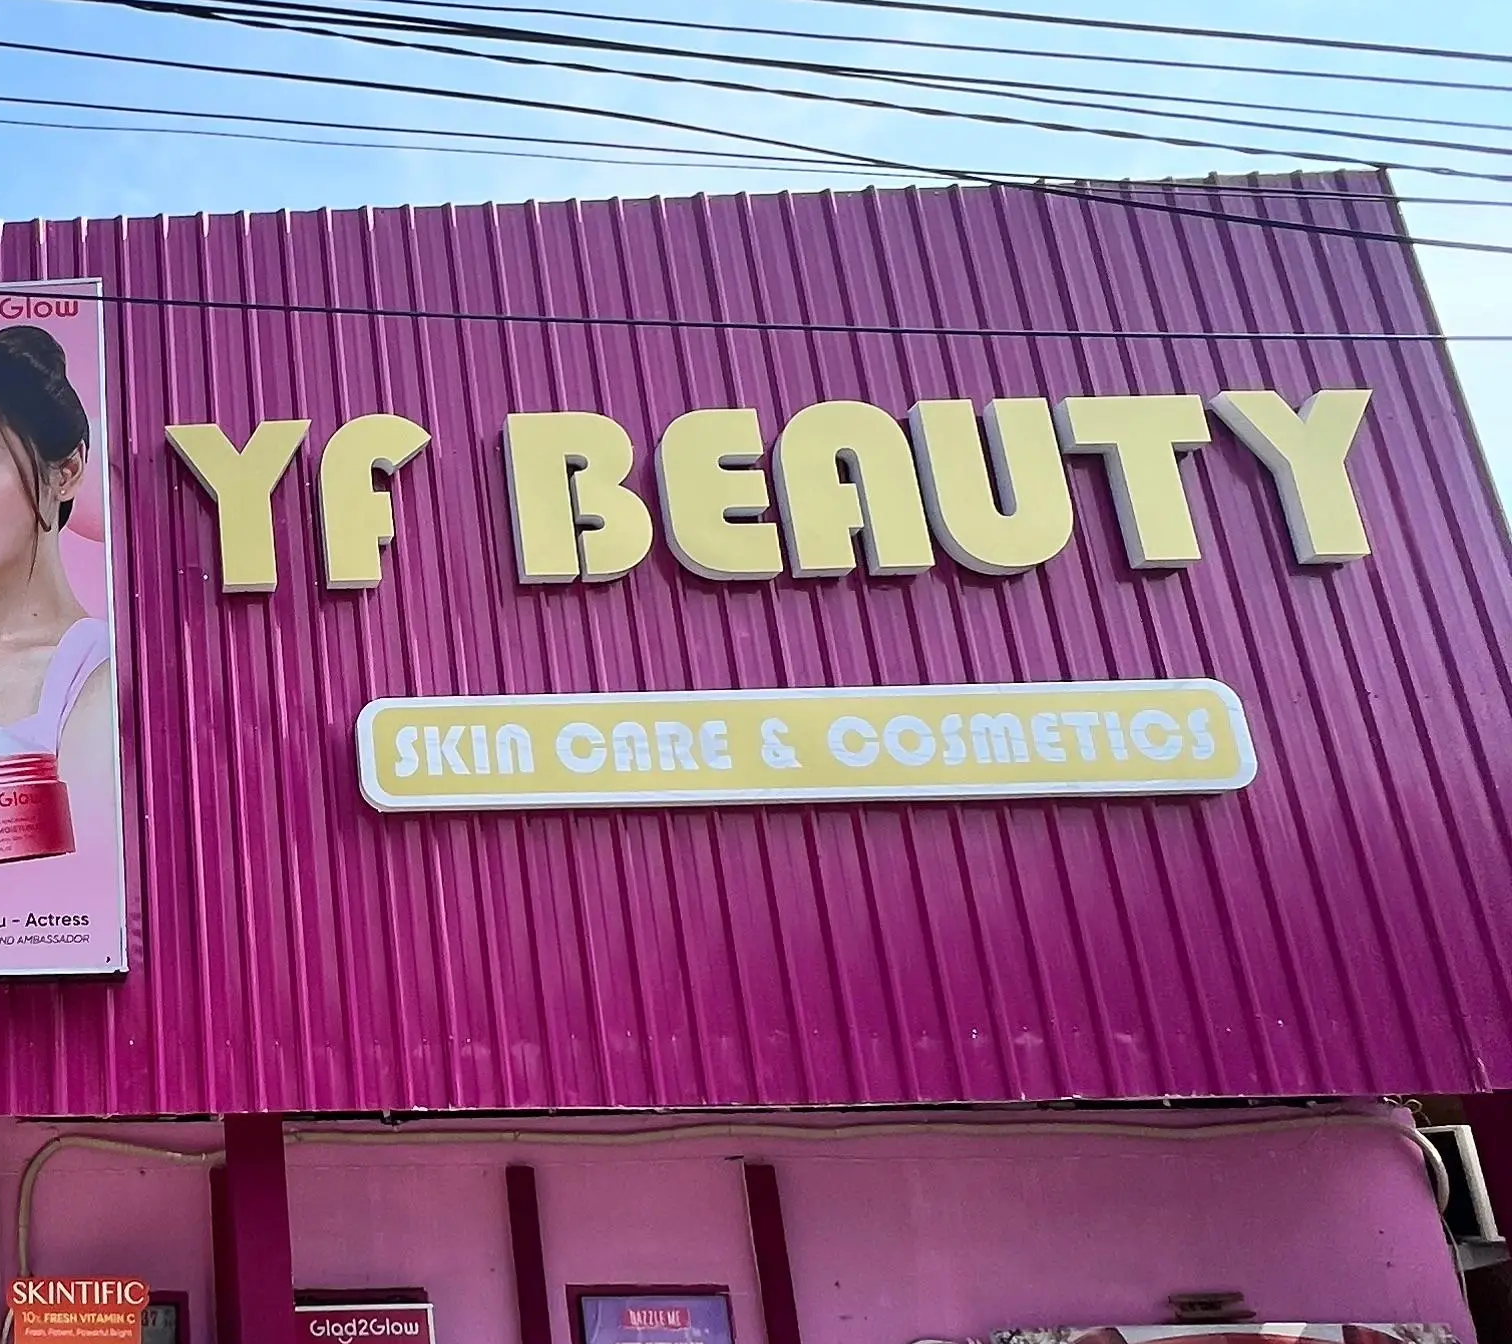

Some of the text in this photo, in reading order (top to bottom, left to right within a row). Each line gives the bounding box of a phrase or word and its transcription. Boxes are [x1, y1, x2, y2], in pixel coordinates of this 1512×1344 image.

[164, 389, 1374, 594] YF BEAUTY
[394, 708, 1217, 777] SKIN CARE & COSMETICS
[25, 912, 90, 927] Actress
[16, 934, 90, 945] AMBASSADOR
[12, 1280, 145, 1305] SKINTIFIC
[43, 1312, 77, 1323] FRESH
[78, 1312, 125, 1324] VITAMIN
[126, 1313, 136, 1324] C
[629, 1309, 681, 1326] DAZZLE ME
[309, 1318, 419, 1340] Glad2Glow
